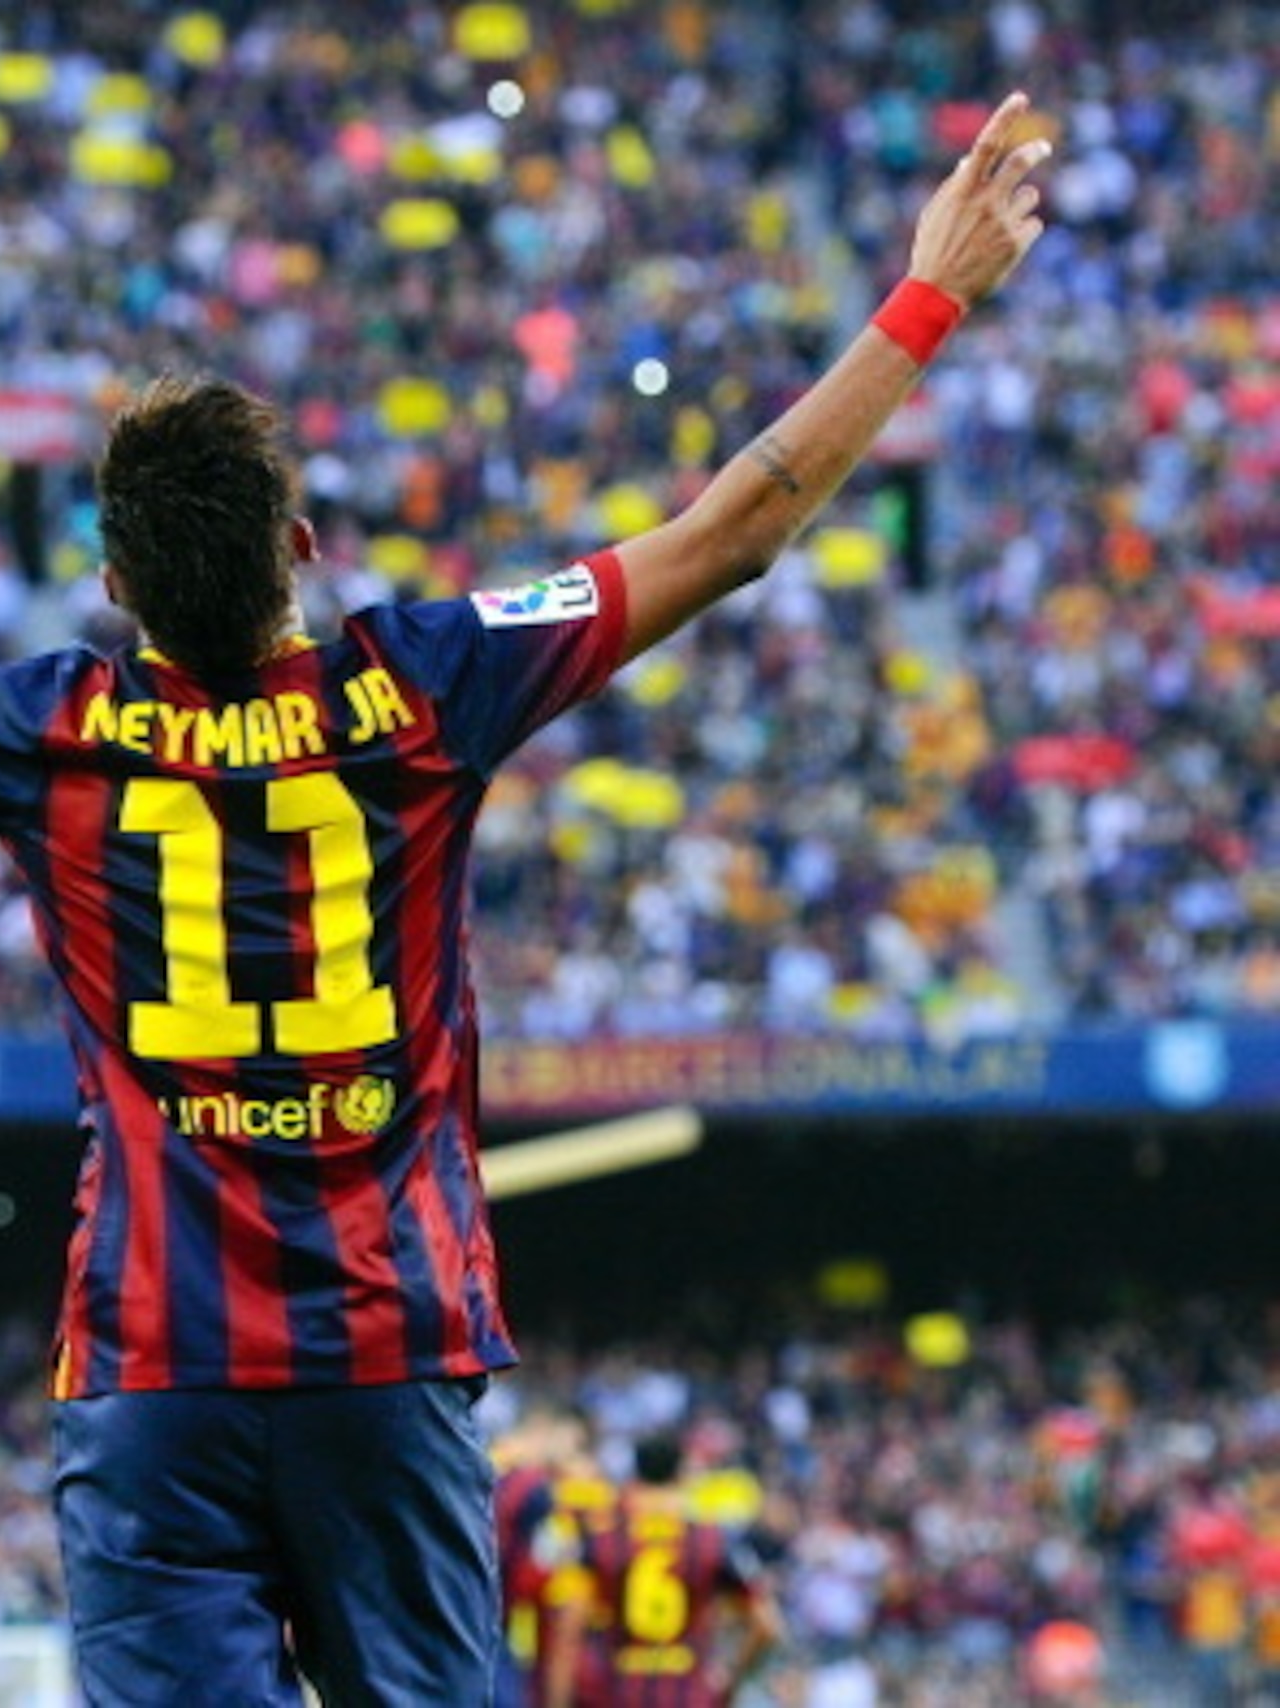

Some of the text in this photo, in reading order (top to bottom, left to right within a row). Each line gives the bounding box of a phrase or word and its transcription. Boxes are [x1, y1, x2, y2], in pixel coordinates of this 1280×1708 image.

[81, 666, 416, 768] NEYMAR JR
[119, 771, 399, 1060] 11
[158, 1083, 330, 1140] unicef
[625, 1545, 688, 1642] 6
